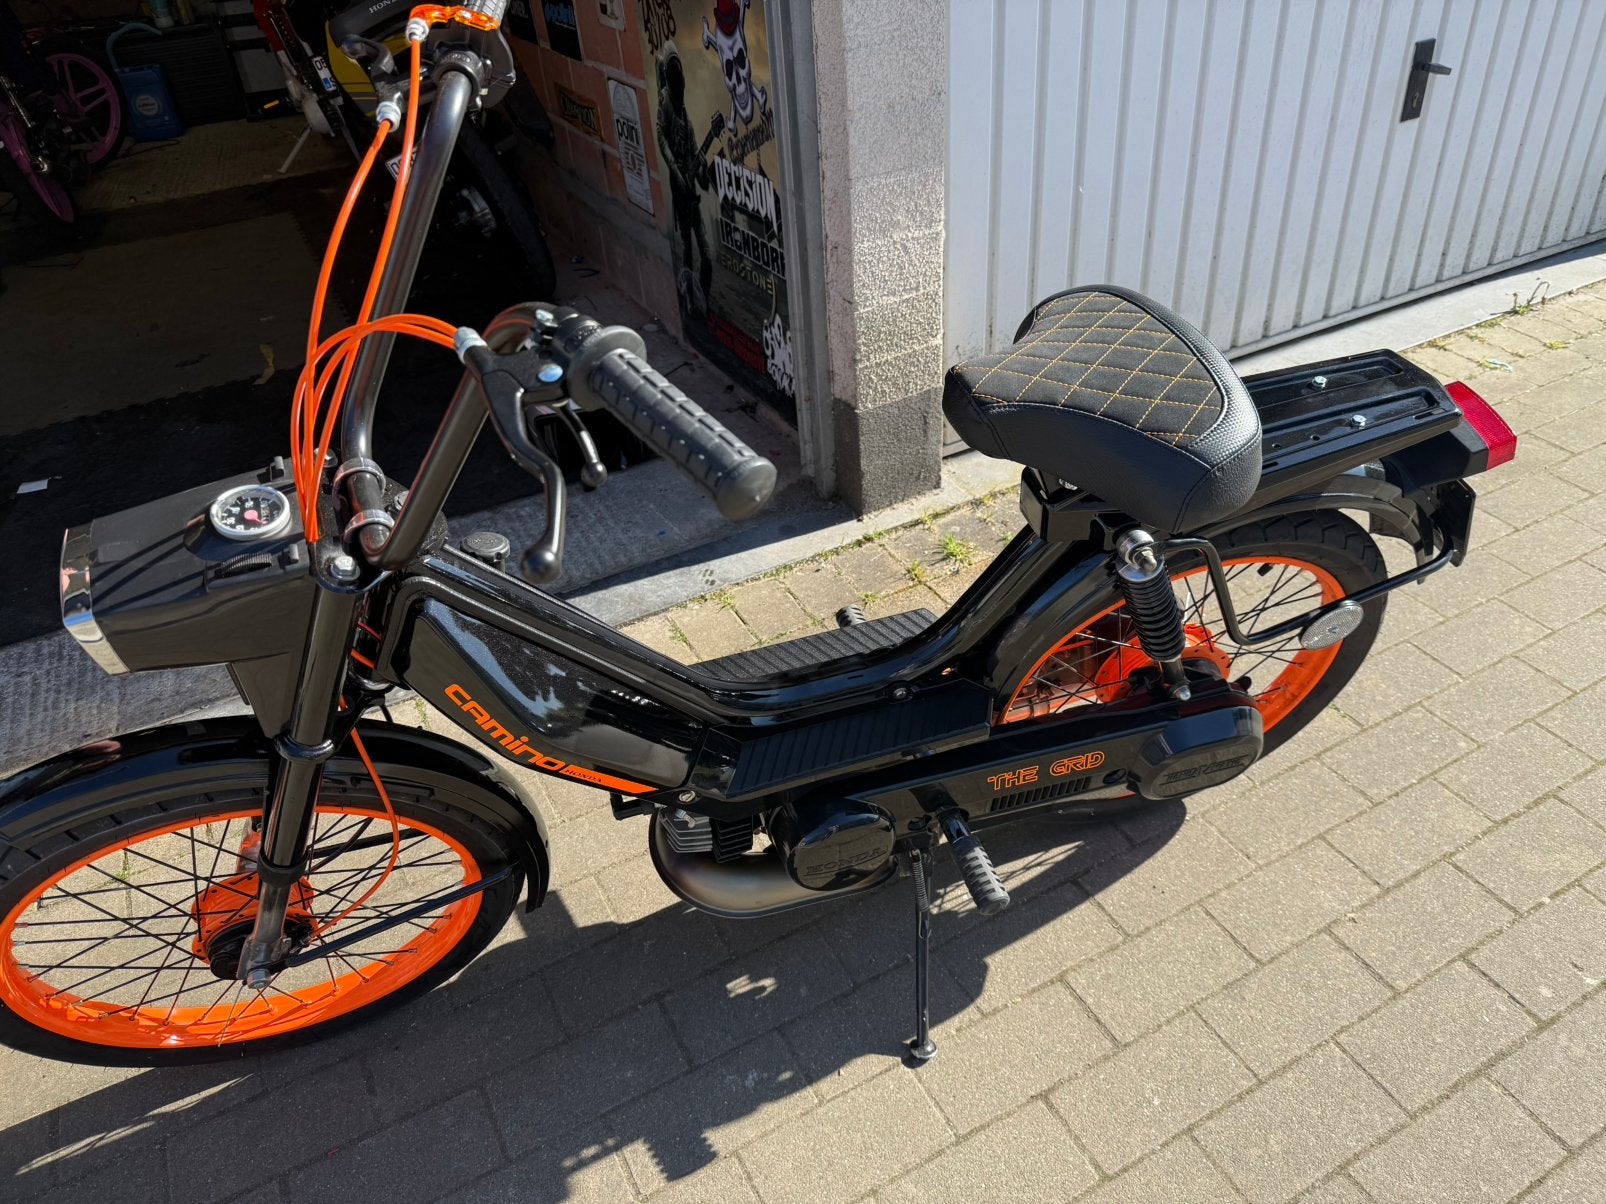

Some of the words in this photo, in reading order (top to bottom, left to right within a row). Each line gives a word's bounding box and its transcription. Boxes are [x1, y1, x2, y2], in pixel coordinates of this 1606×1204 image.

[713, 154, 778, 236] DECISION
[565, 769, 602, 783] HONDA
[987, 765, 1039, 791] THE
[1049, 751, 1106, 777] GRID
[807, 848, 888, 875] HONDA
